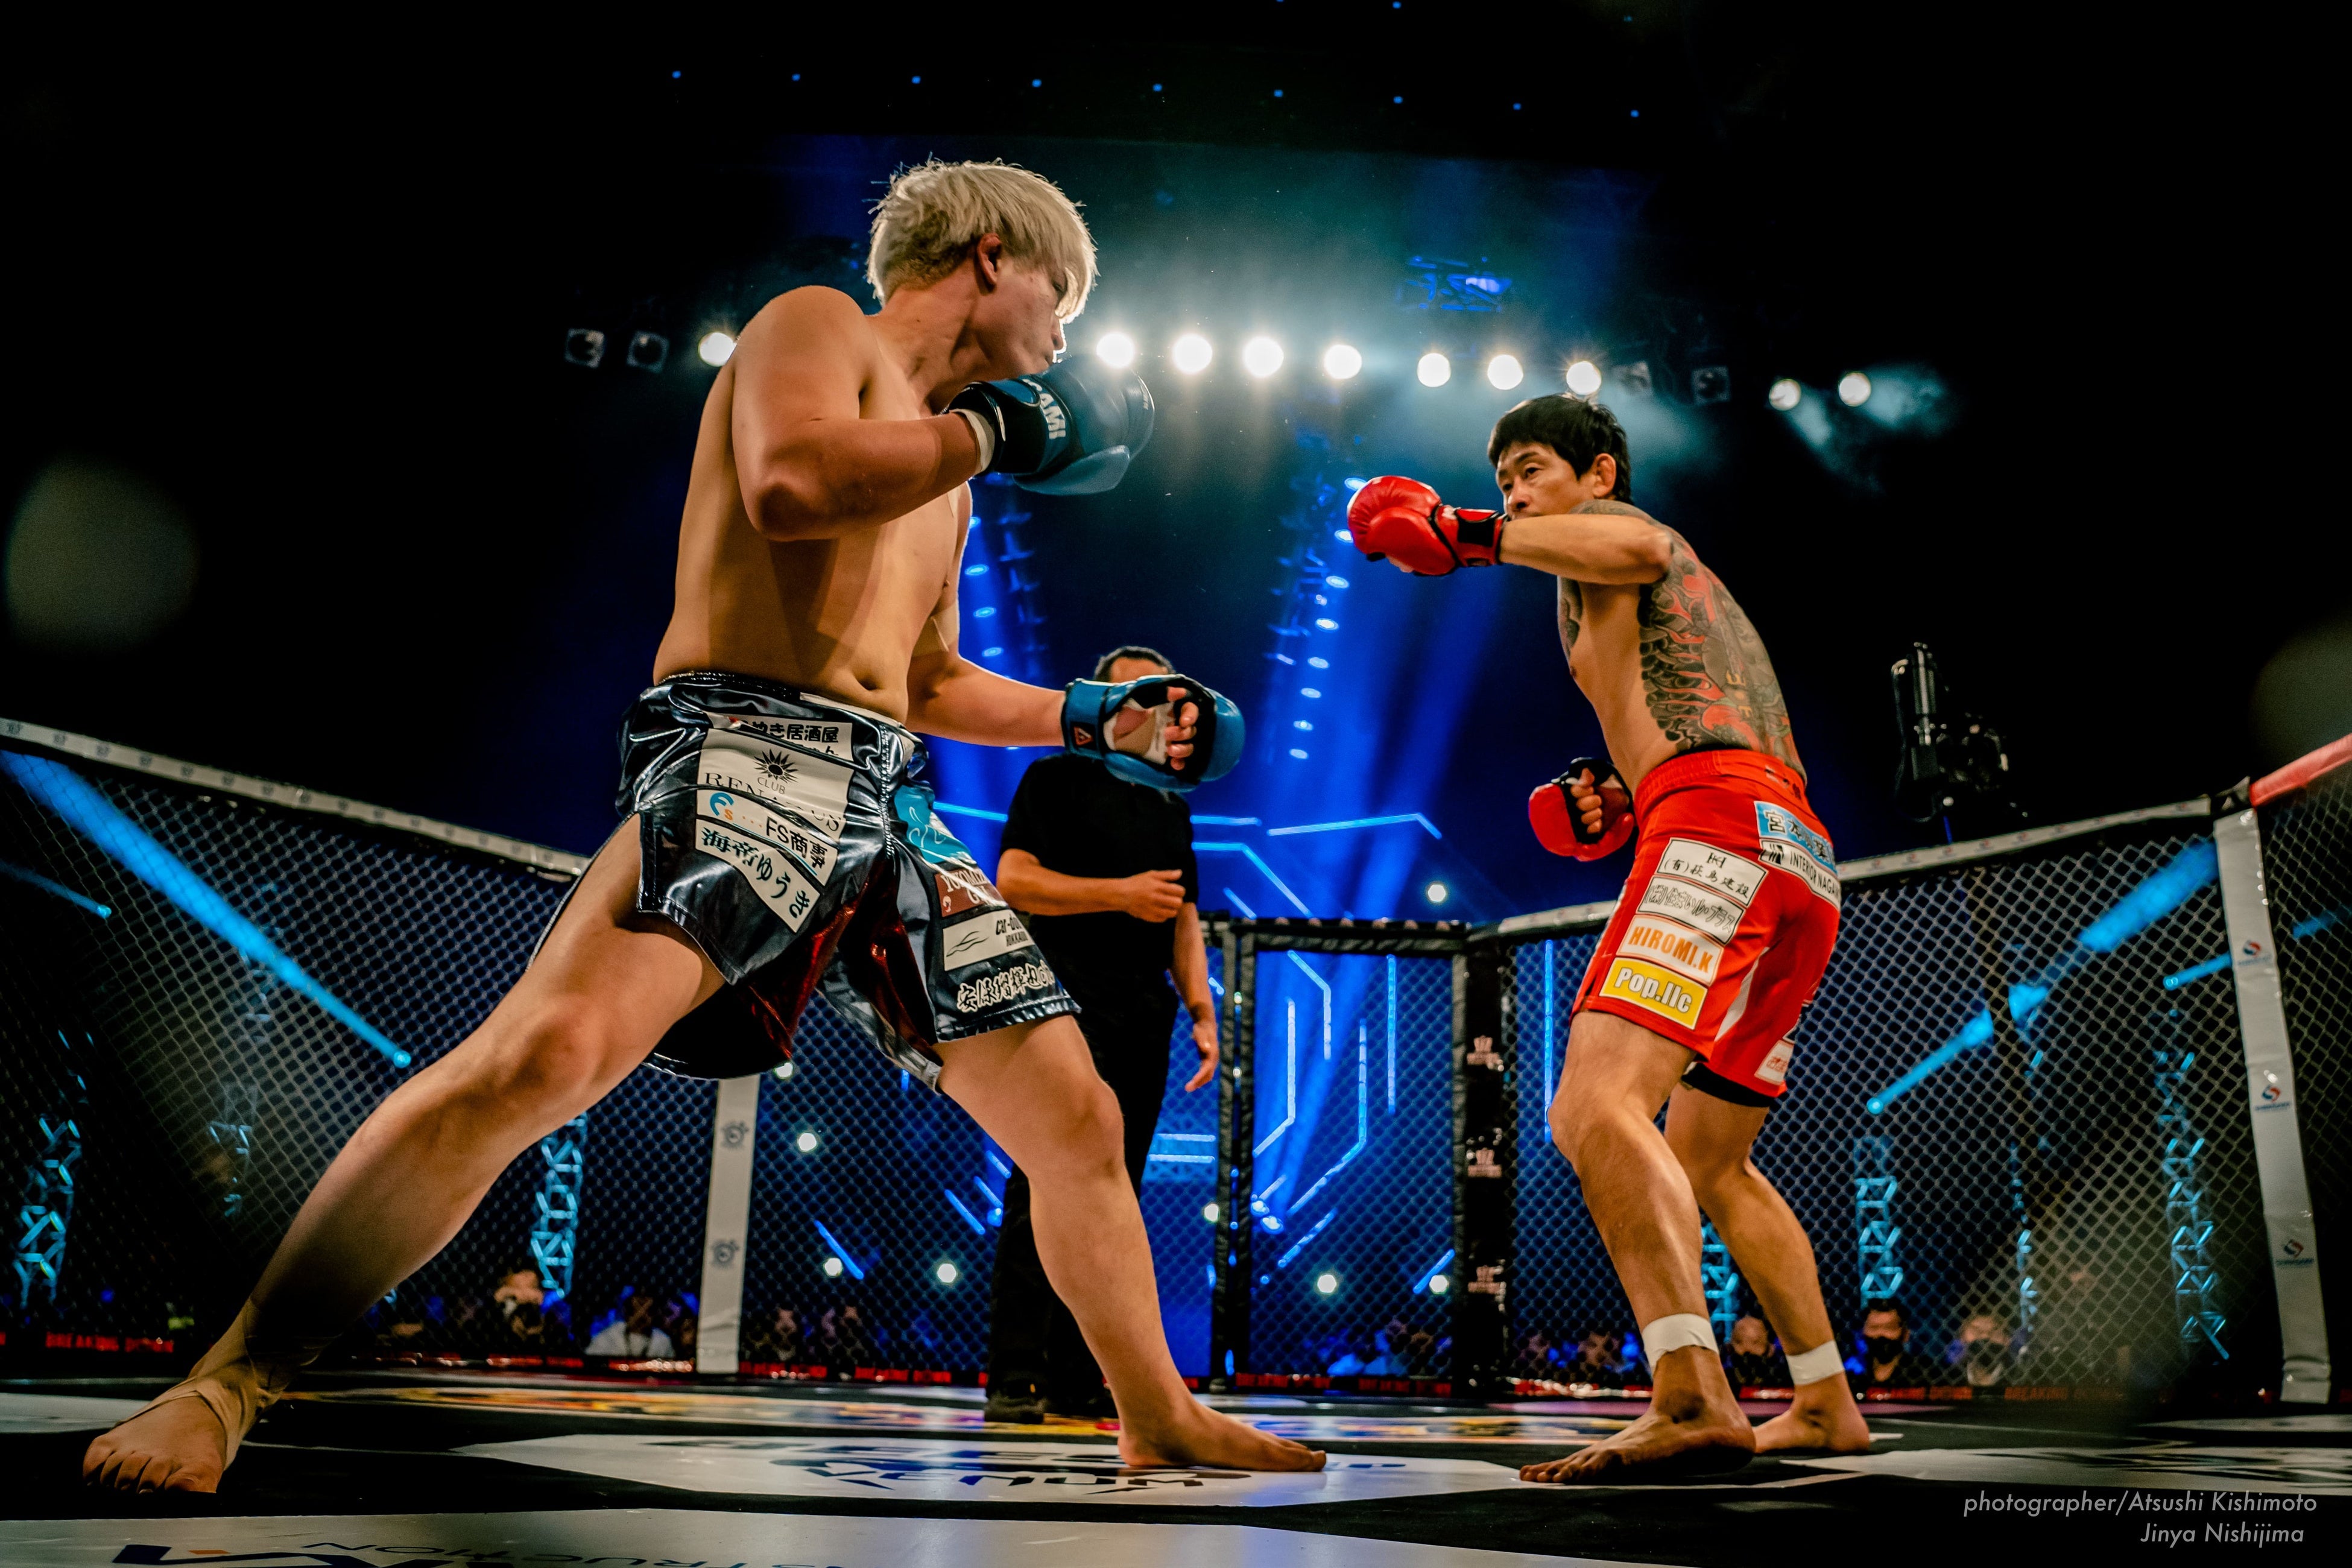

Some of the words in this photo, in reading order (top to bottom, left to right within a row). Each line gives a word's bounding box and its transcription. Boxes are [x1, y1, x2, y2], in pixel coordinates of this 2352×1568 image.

[706, 772, 841, 832] RENUS
[757, 776, 786, 795] CLUB
[766, 815, 828, 869] FS商事
[1790, 851, 1818, 880] INTERIOR
[1629, 926, 1713, 973] HIROMI.K
[1614, 967, 1693, 1013] Pop.llc
